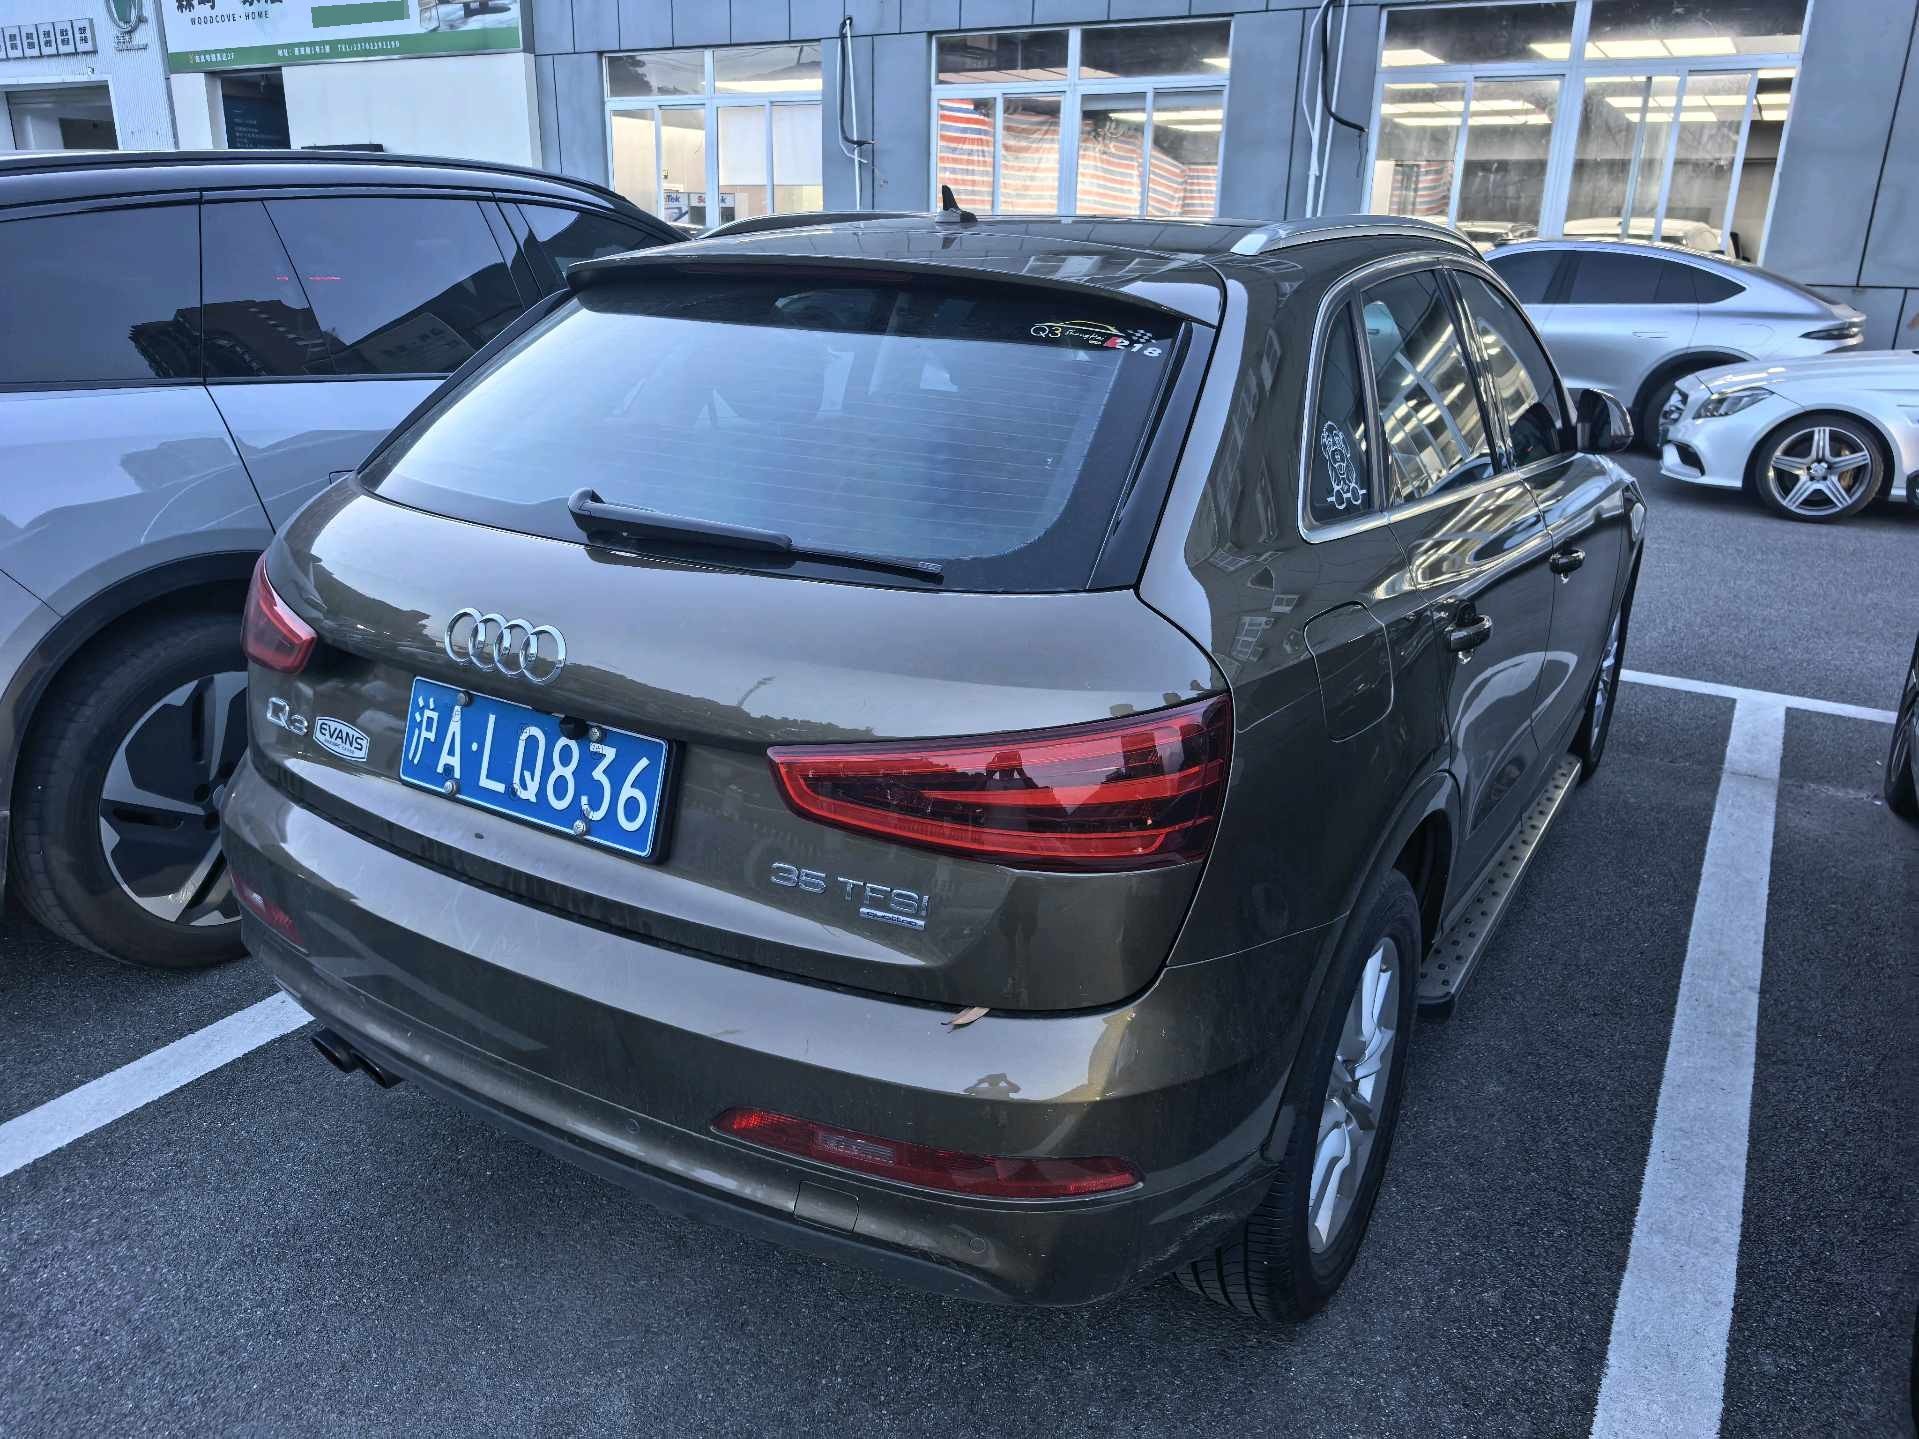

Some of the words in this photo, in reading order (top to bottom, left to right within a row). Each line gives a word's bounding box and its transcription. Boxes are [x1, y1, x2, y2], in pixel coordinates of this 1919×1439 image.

[1030, 325, 1062, 338] Q3
[266, 697, 308, 736] Q3
[319, 722, 364, 752] EVANS
[770, 862, 827, 894] 35
